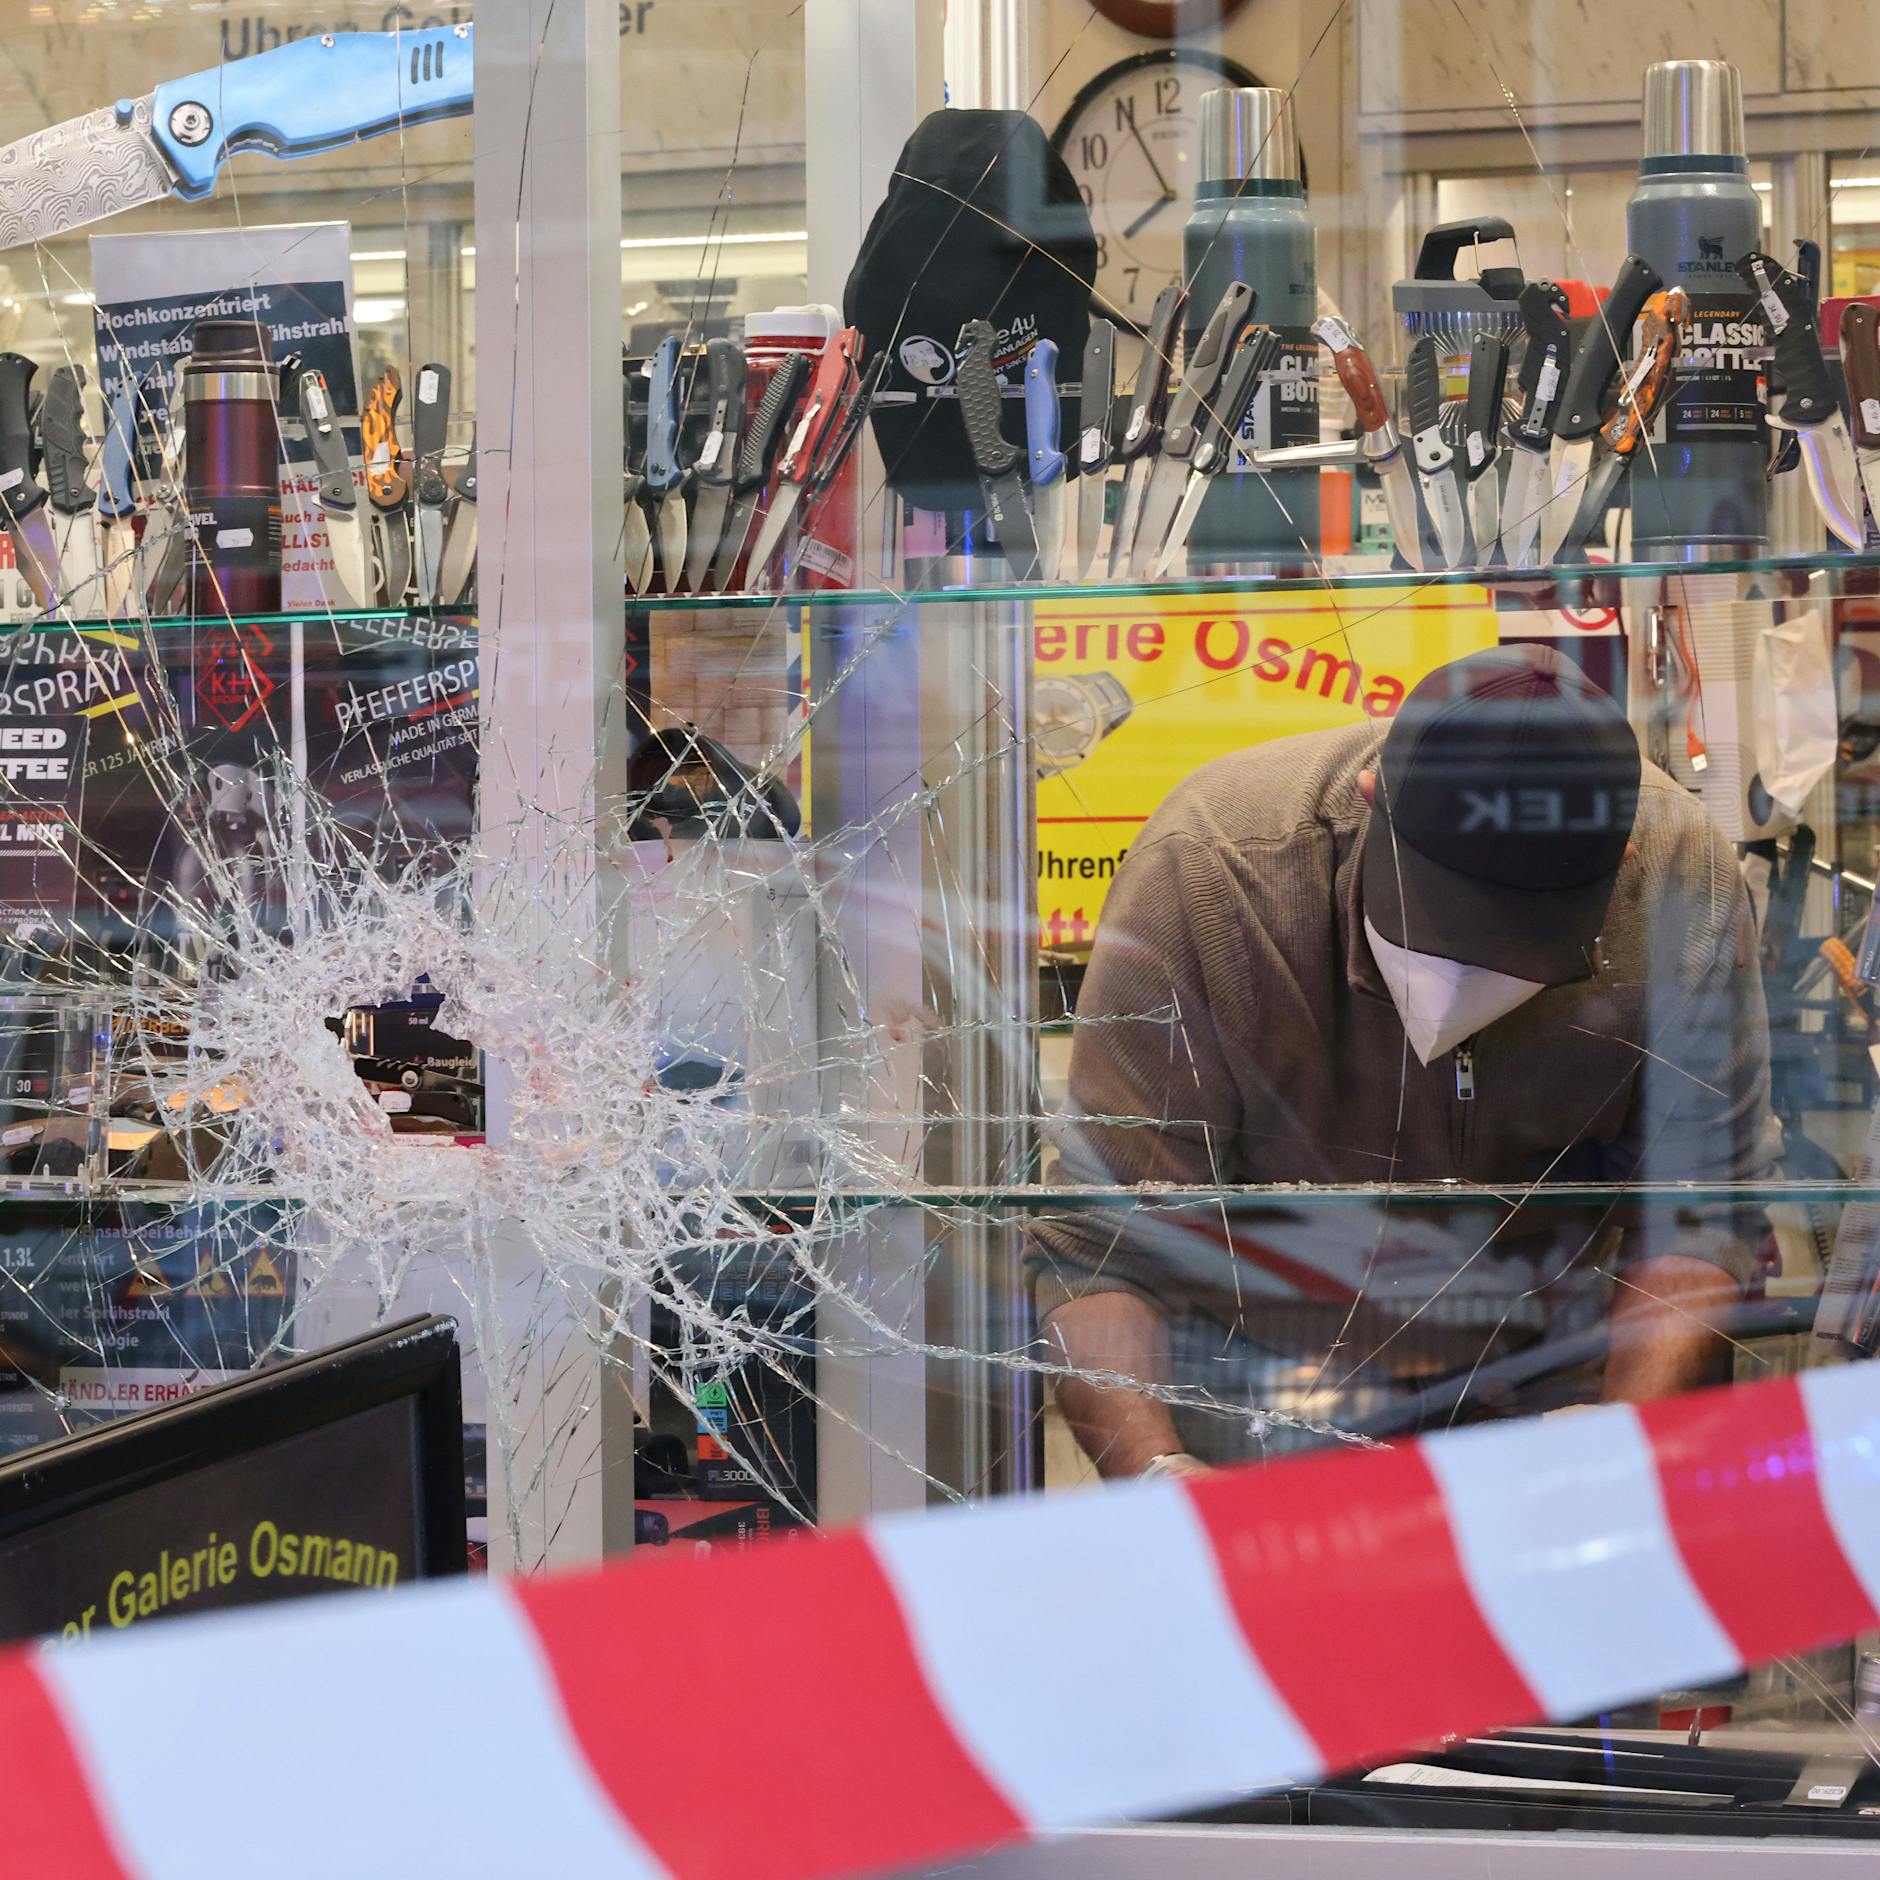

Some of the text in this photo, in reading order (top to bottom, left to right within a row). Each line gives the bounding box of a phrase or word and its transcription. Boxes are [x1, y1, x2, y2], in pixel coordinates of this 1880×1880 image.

[1154, 77, 1182, 115] 12
[1081, 133, 1108, 171] 10
[1123, 267, 1141, 304] 7
[97, 293, 272, 331] Hochkonzentriert
[1693, 310, 1741, 318] LEGENDARY
[1679, 322, 1765, 347] CLASSIC
[100, 335, 196, 363] Windstab
[1280, 381, 1320, 403] BOT
[334, 655, 480, 734] PFEFFERSP
[0, 727, 68, 750] EED
[389, 705, 480, 747] MADE IN GERM
[99, 752, 124, 772] 125
[126, 734, 178, 765] JAHREN
[411, 734, 456, 762] QUALITÄT
[16, 823, 65, 842] MUG
[1038, 848, 1128, 879] hren
[407, 1016, 418, 1026] 50
[16, 1079, 32, 1093] 30
[4, 1247, 36, 1268] 1.3L
[108, 1532, 238, 1629] Galerie
[249, 1520, 399, 1592] Osmann
